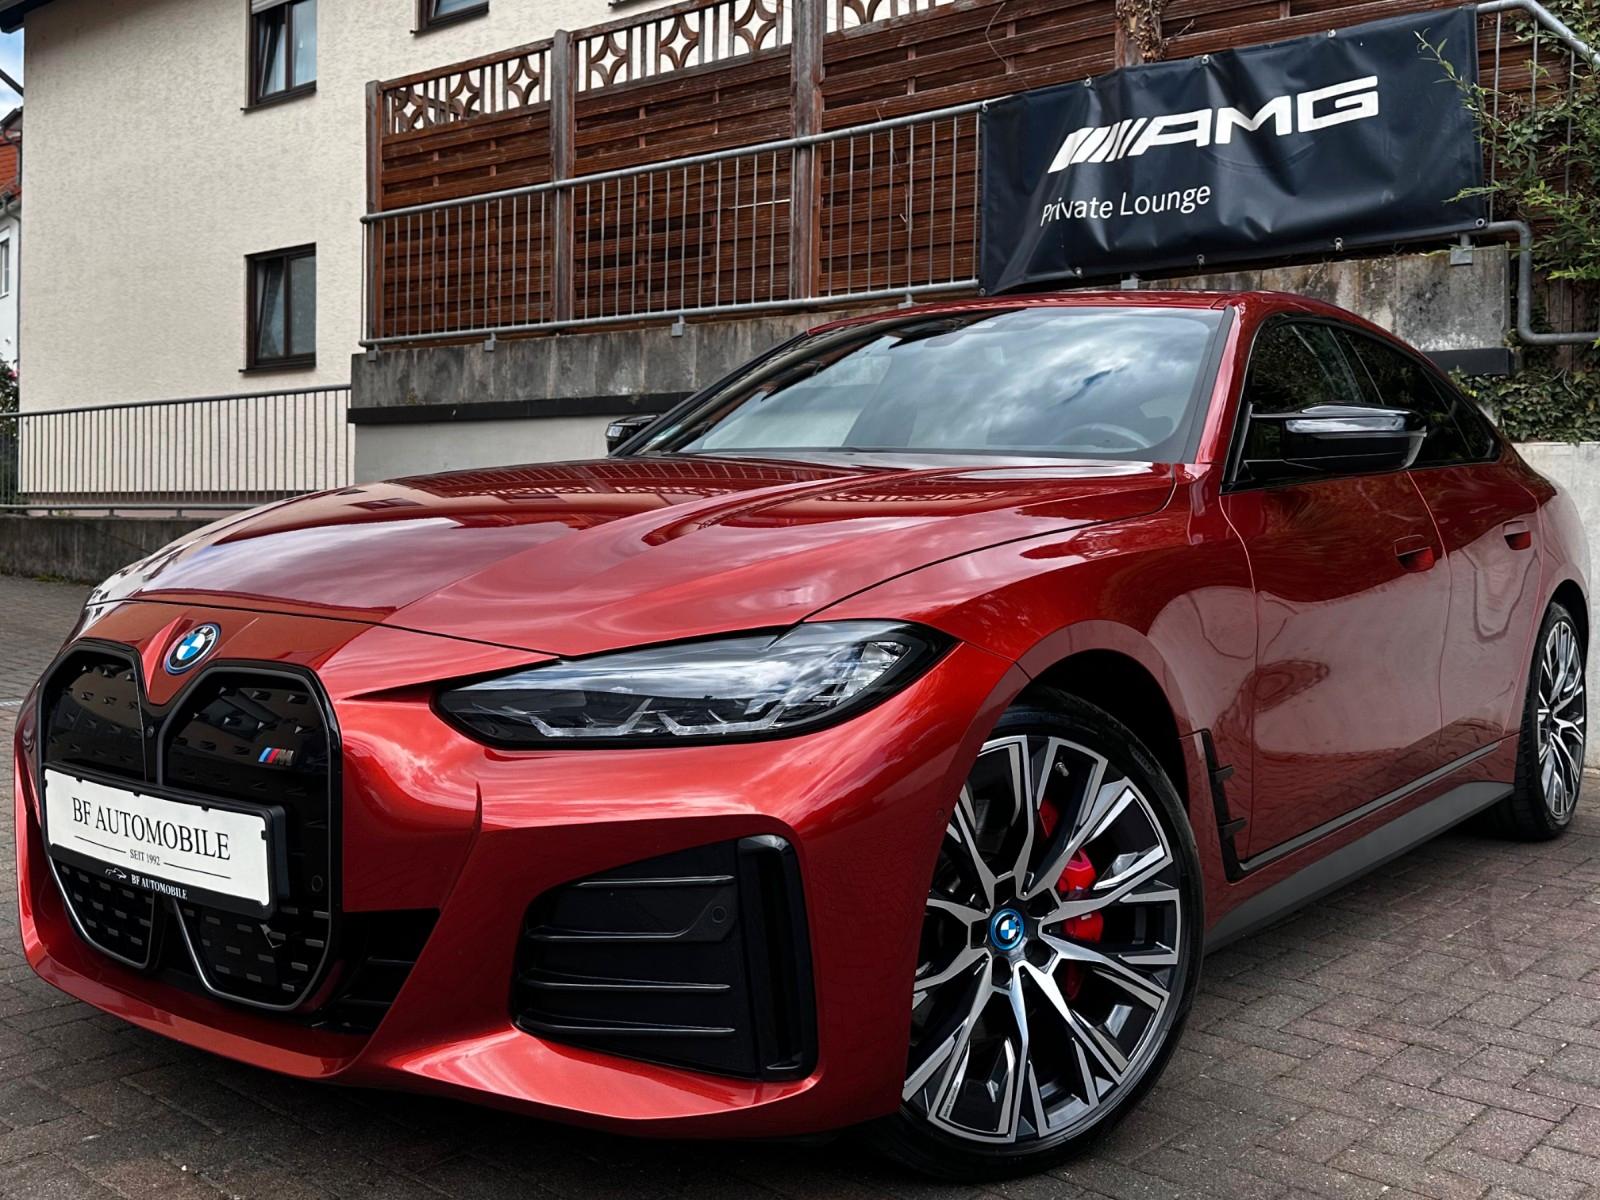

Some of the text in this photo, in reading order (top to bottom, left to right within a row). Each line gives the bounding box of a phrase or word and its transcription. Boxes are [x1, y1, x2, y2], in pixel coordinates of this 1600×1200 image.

[1128, 76, 1379, 156] AMG
[1040, 185, 1211, 227] Private Lounge
[72, 797, 231, 861] BF AUTOMOBILE
[129, 849, 161, 866] SEIT 1992
[131, 874, 188, 900] BF AUTOMOBILE
